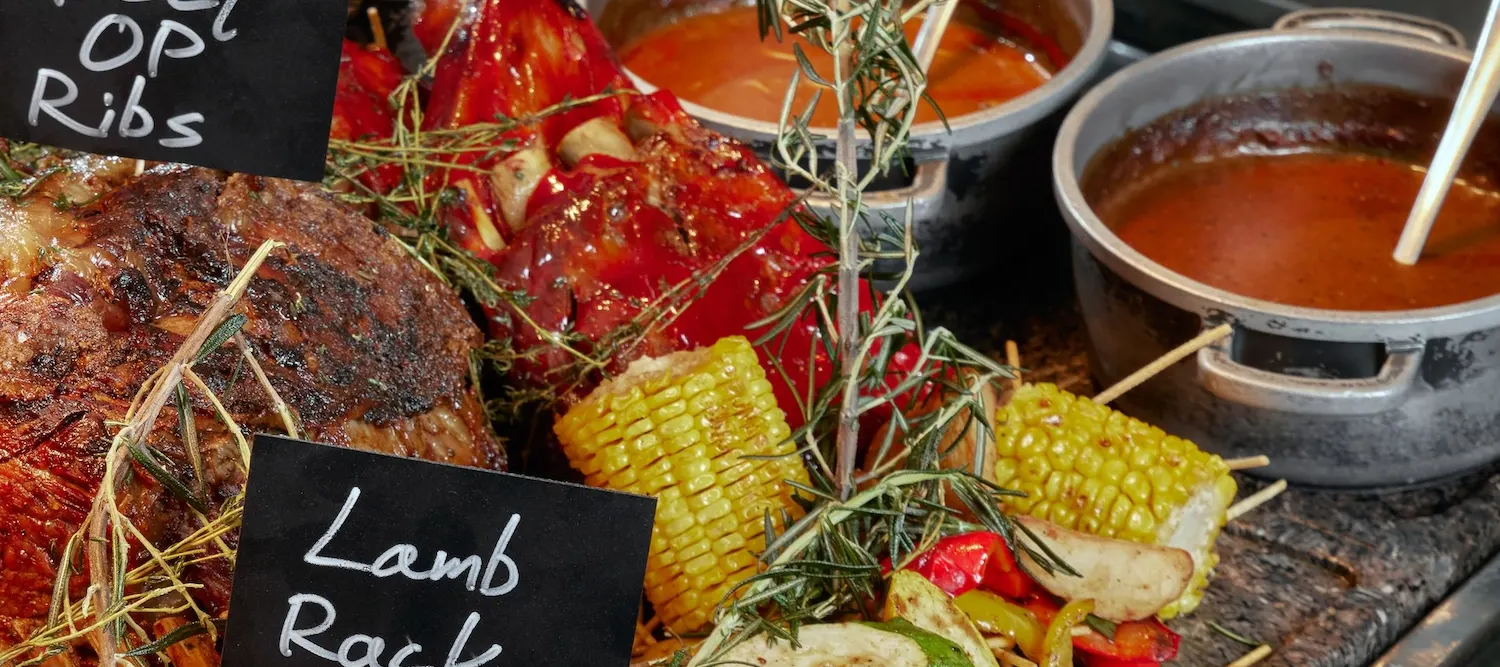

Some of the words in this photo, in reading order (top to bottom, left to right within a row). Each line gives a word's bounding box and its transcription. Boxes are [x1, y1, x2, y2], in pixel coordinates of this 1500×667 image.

[79, 13, 205, 77] OP
[28, 67, 205, 148] Ribs
[303, 486, 521, 597] Lamb
[279, 593, 503, 667] Rack
